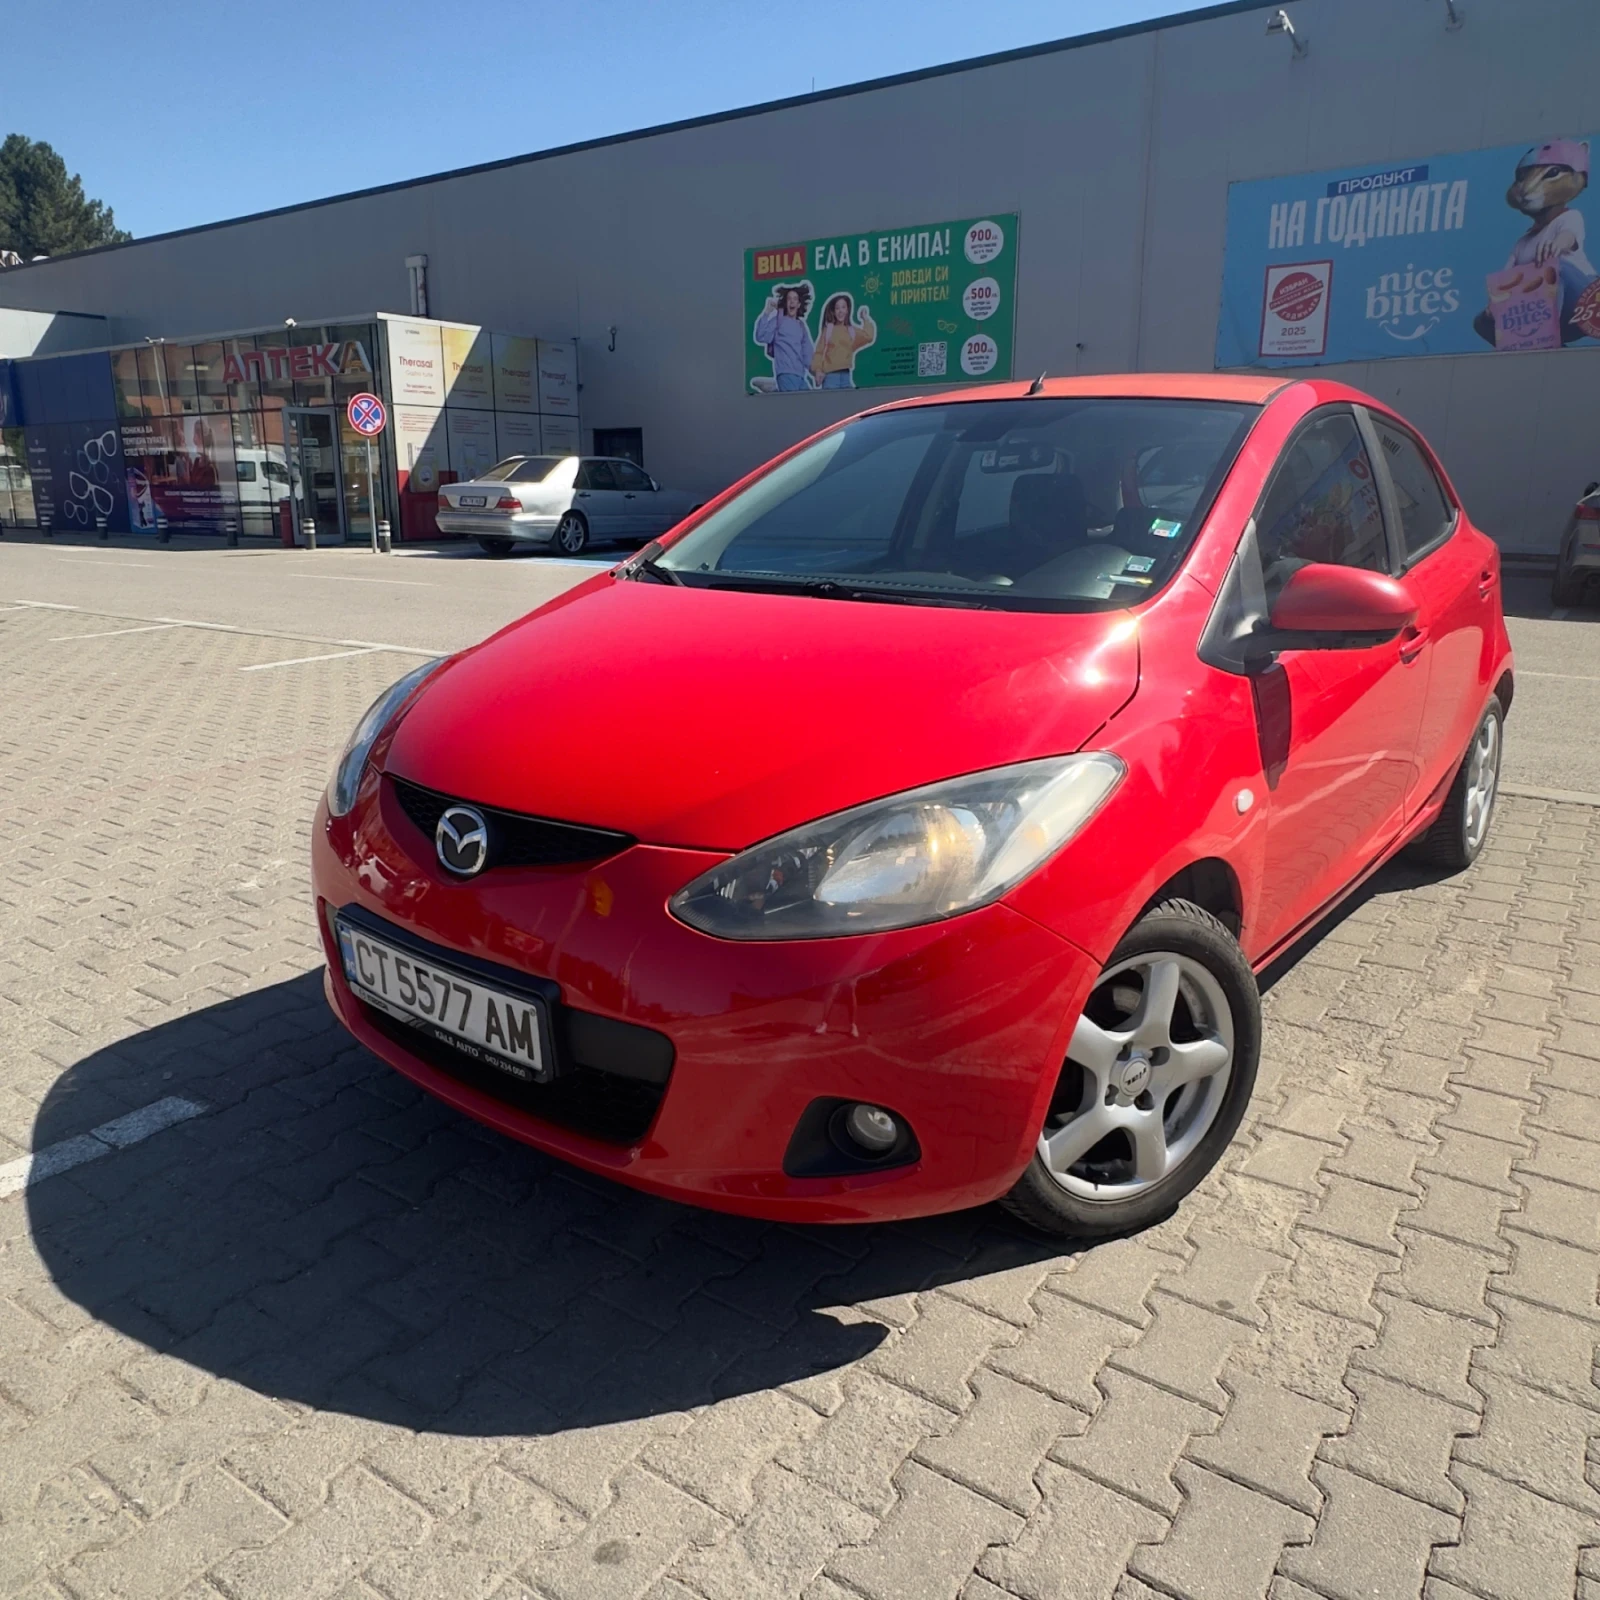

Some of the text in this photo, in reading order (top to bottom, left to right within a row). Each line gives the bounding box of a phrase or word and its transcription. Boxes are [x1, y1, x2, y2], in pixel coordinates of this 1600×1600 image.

[1338, 168, 1415, 194] ПРОДУКТ
[1268, 180, 1468, 249] НА ГОДИНАТА
[970, 228, 992, 242] 900
[815, 228, 951, 271] ЕЛА В ЕКИПА!
[757, 252, 804, 275] BILLA
[891, 265, 950, 287] ДОВЕДИ СИ
[1279, 277, 1309, 295] ИЗБРАН
[1378, 263, 1454, 293] nice
[891, 286, 950, 305] И ПРИЯТЕЛ!
[971, 286, 992, 299] 500
[1366, 286, 1460, 324] bites
[1507, 299, 1546, 317] nice
[1502, 307, 1552, 330] bites
[1281, 327, 1307, 336] 2025
[967, 342, 988, 354] 200
[223, 341, 373, 383] АПТЕКА
[399, 355, 434, 369] Therasal
[356, 938, 535, 1061] CT 5577 AM
[456, 1041, 479, 1057] AUTO
